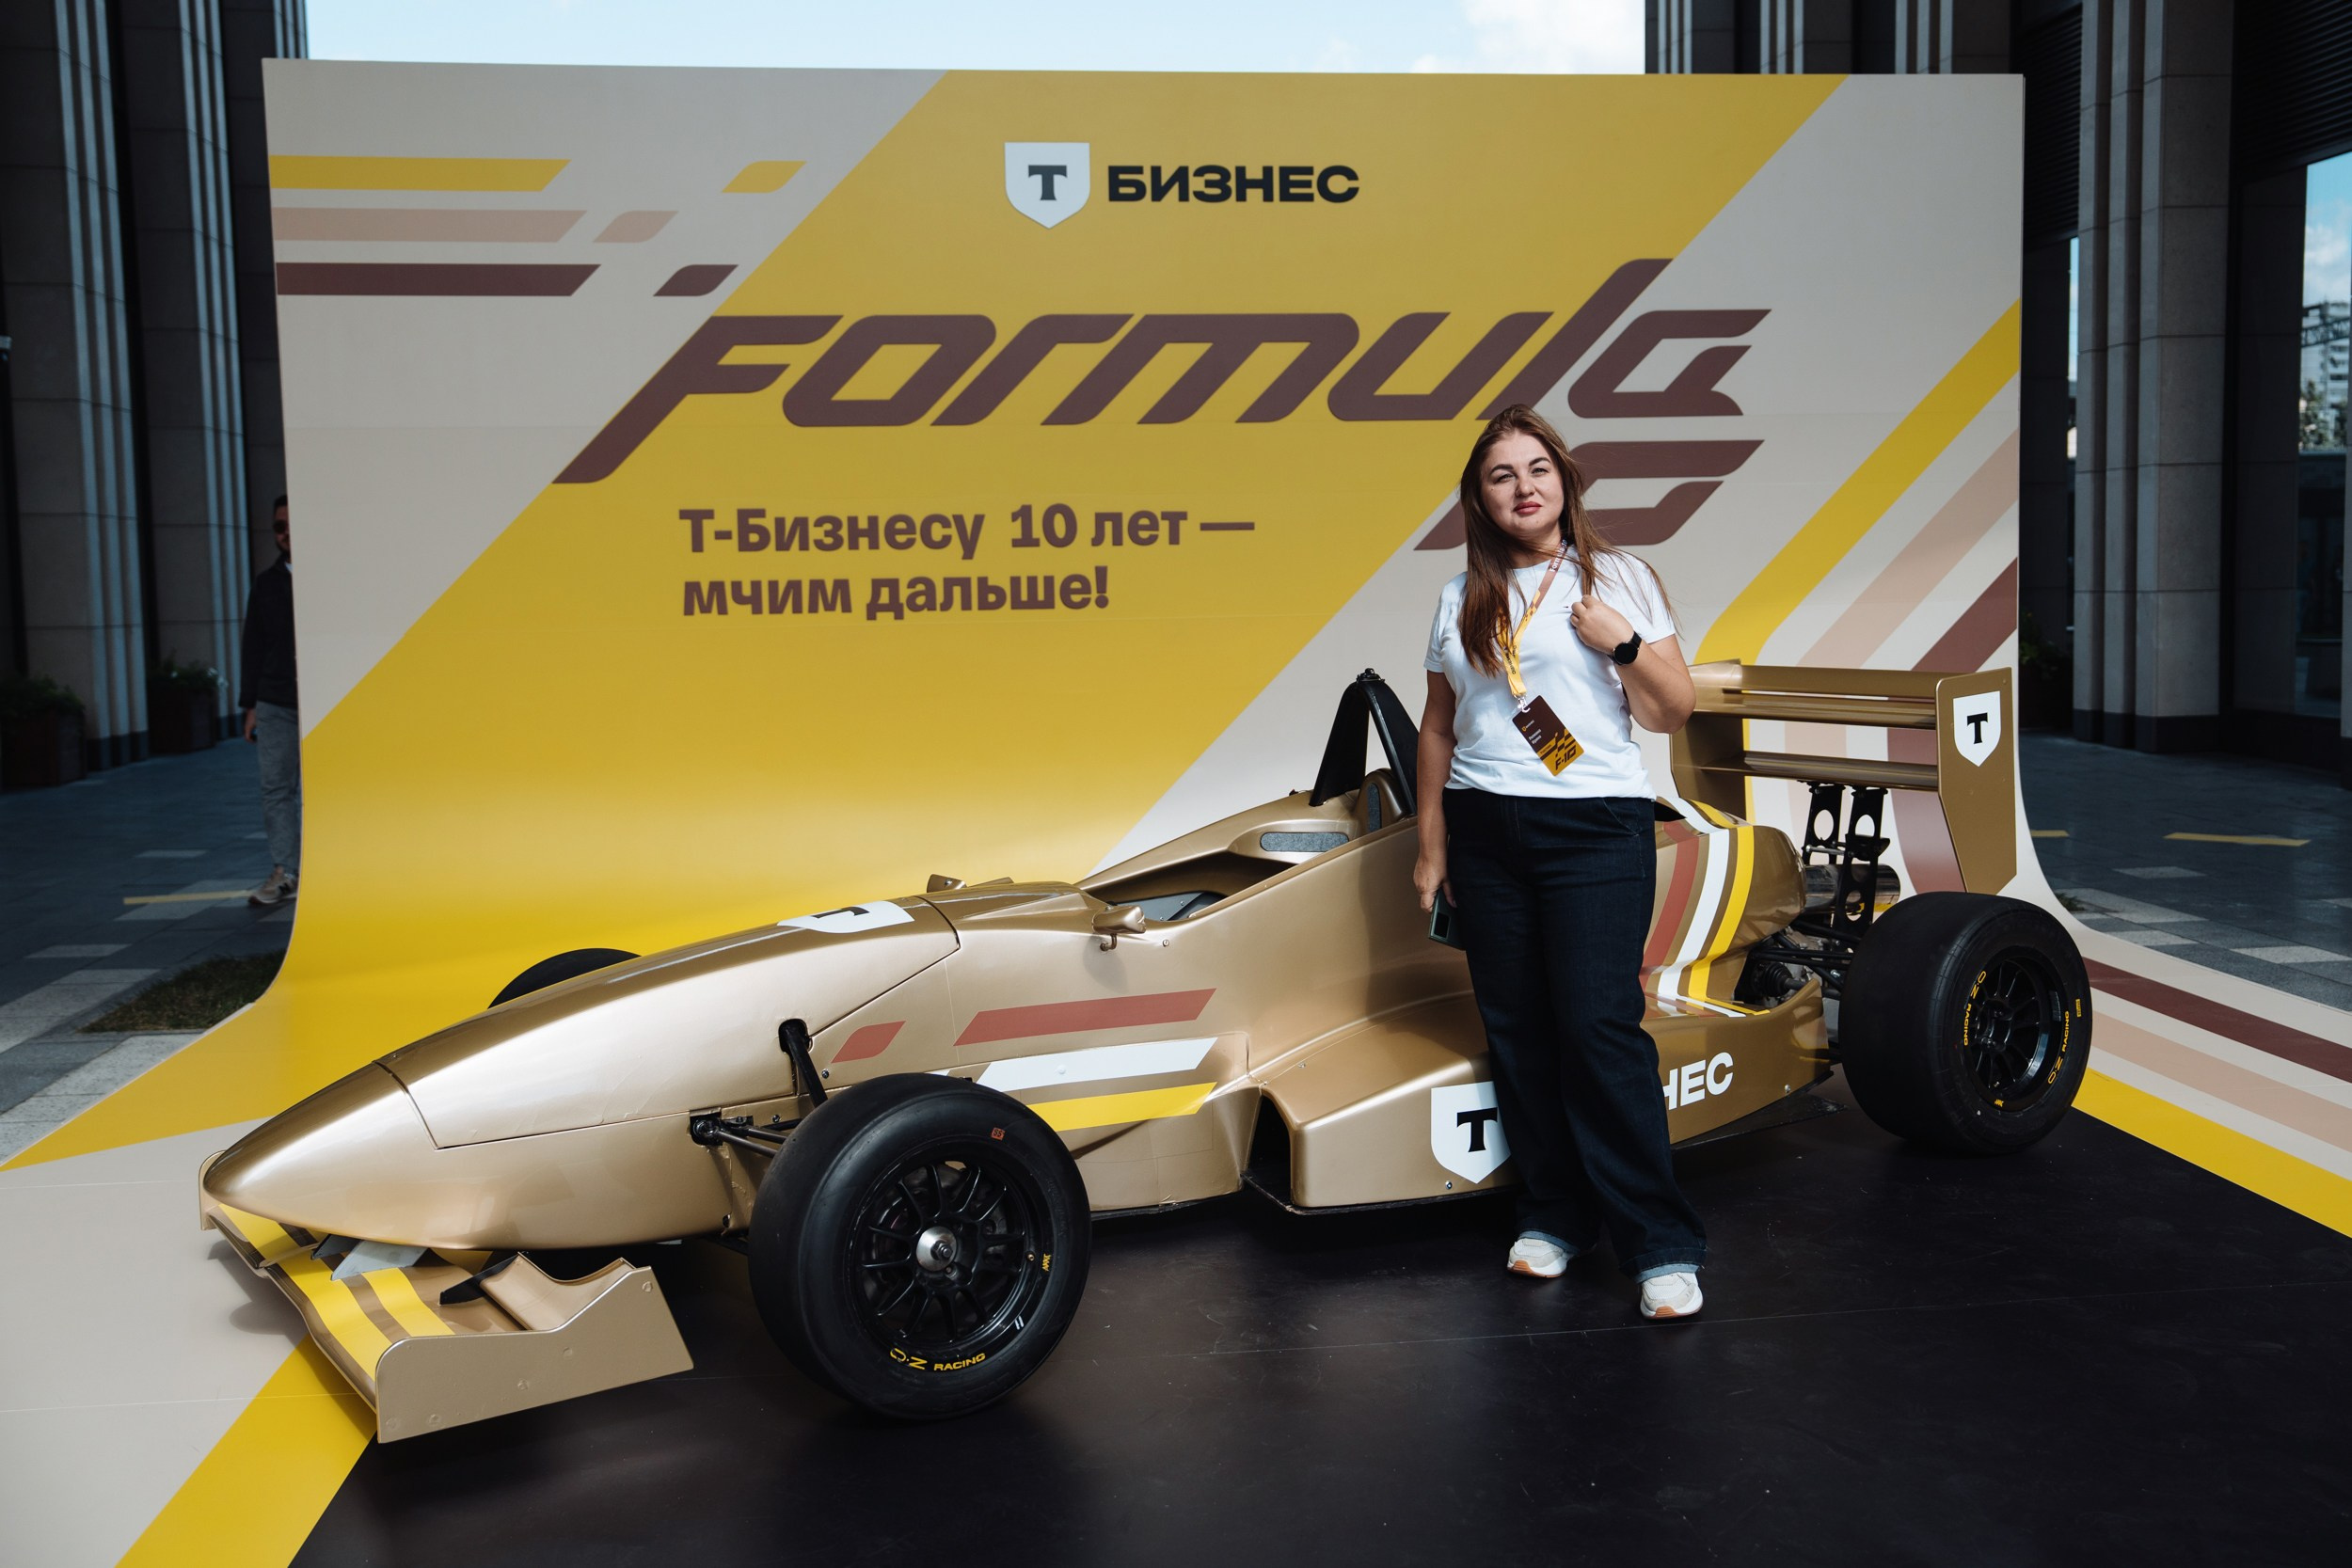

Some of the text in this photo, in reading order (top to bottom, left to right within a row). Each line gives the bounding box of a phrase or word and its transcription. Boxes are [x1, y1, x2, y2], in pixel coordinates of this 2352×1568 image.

[1107, 164, 1360, 204] БИЗНЕС
[678, 507, 986, 561] Т-Бизнесу
[1010, 502, 1078, 548] 10
[1090, 510, 1188, 546] лет
[683, 565, 1110, 622] мчим дальше!
[1963, 1003, 1972, 1046] RACING
[2061, 1011, 2070, 1053] RACING
[933, 1353, 986, 1370] RACING
